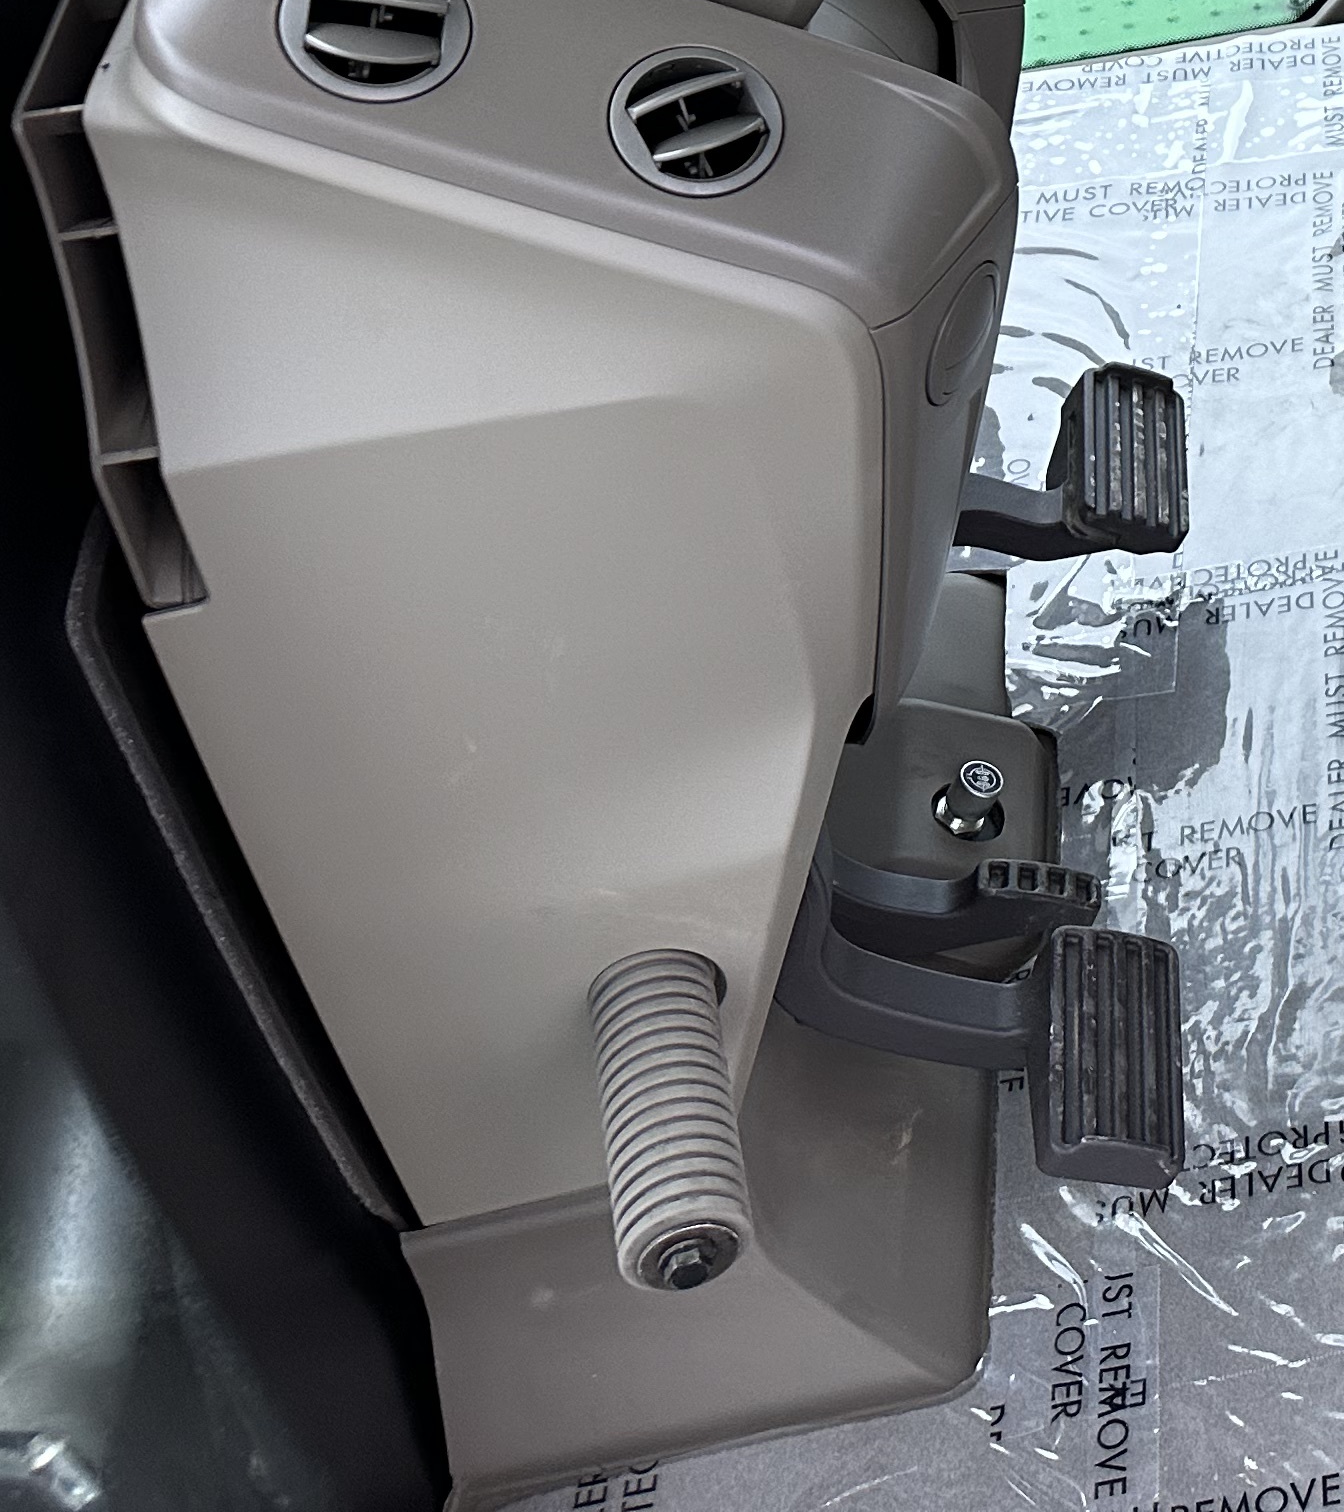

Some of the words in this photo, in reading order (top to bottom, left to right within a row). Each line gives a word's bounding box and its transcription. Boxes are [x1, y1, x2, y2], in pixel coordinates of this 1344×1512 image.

[1176, 36, 1316, 65] PROTECTIVE
[1230, 53, 1316, 73] DEALER
[1322, 36, 1343, 97] REMOVE
[1022, 72, 1126, 93] REMOVE
[1146, 66, 1212, 85] MUST
[1037, 184, 1113, 205] MUST
[1089, 198, 1178, 218] COVER
[1214, 191, 1306, 212] DEALER
[1312, 170, 1334, 238] REMOVE
[1312, 246, 1335, 293] MUST
[1188, 337, 1305, 365] REMOVE
[1313, 302, 1336, 369] DEALER
[1205, 590, 1315, 626] DEALER
[1179, 802, 1319, 847] REMOVE
[1198, 1158, 1332, 1205] DEALER
[1050, 1301, 1088, 1424] COVER
[1094, 1342, 1133, 1500] REMOVE
